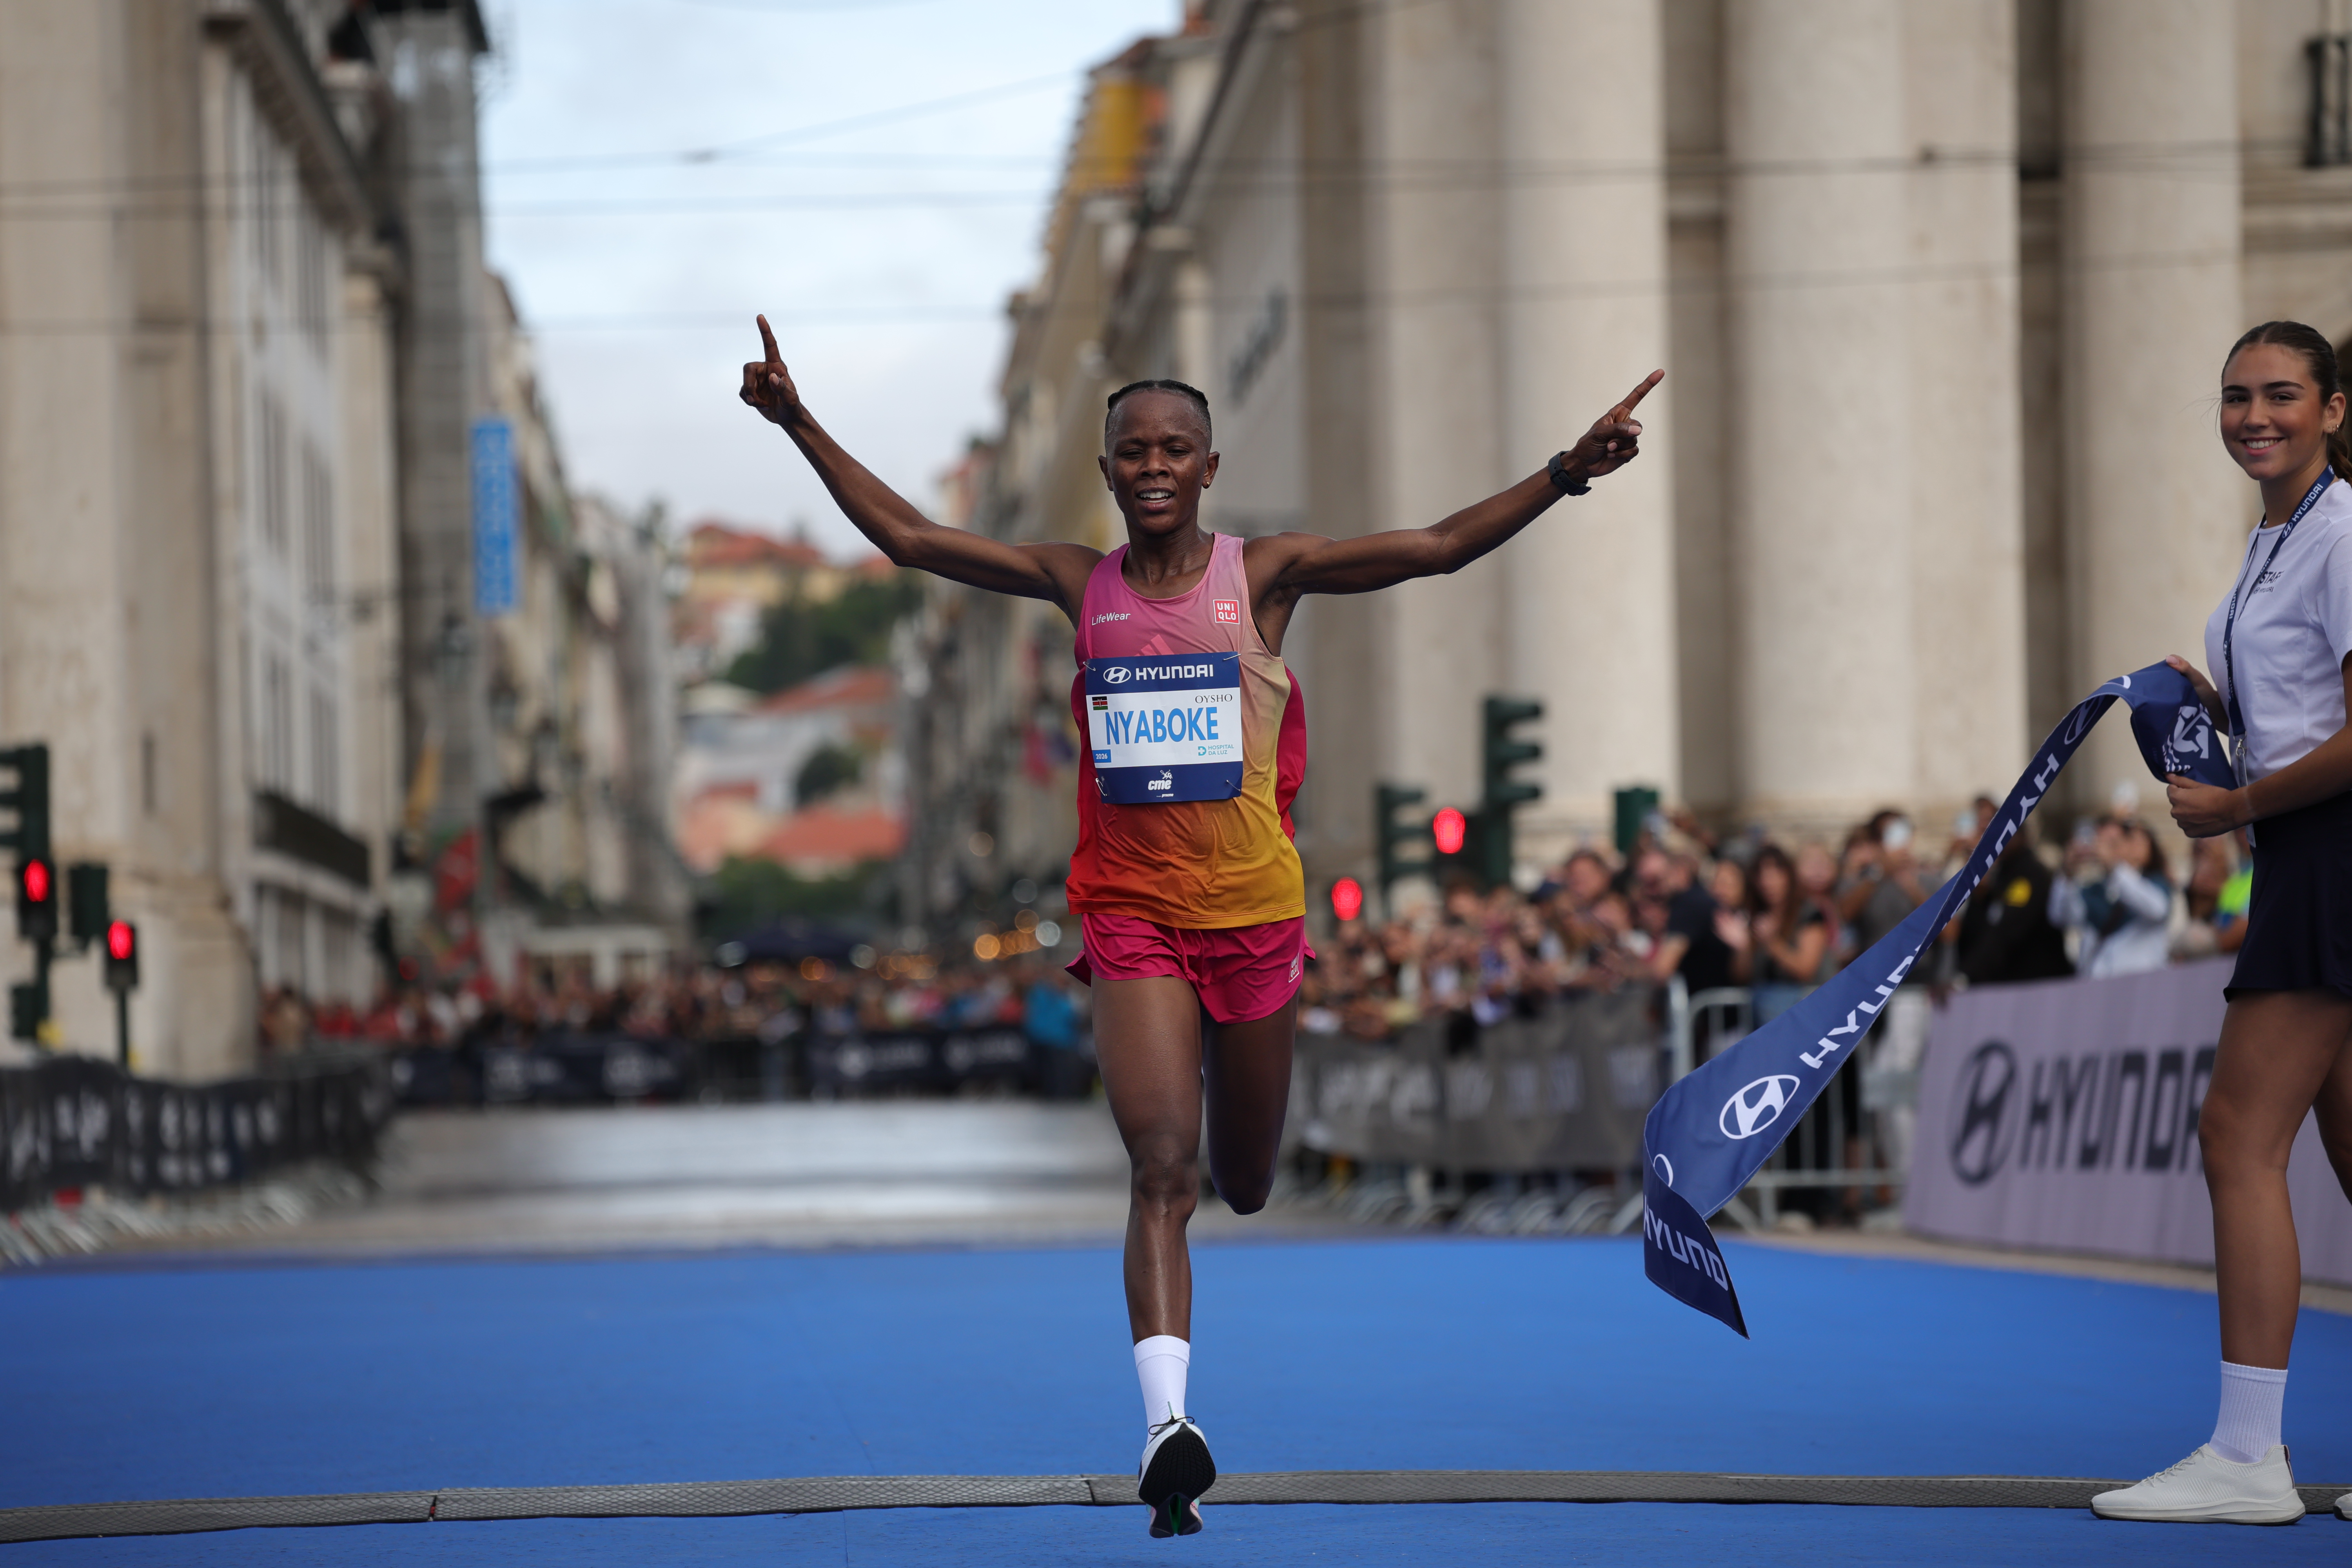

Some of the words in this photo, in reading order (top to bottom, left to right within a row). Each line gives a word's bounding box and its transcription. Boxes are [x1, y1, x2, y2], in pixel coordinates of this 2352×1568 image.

[2292, 483, 2324, 522] HYUNDAI
[1217, 603, 1235, 611] UNI
[1091, 612, 1131, 626] LifeWear
[1218, 612, 1236, 621] QLO
[1135, 664, 1214, 681] HYUNDAI
[1195, 694, 1233, 704] OYSHO
[1105, 706, 1219, 745] NYABOKE
[1148, 780, 1172, 790] cme
